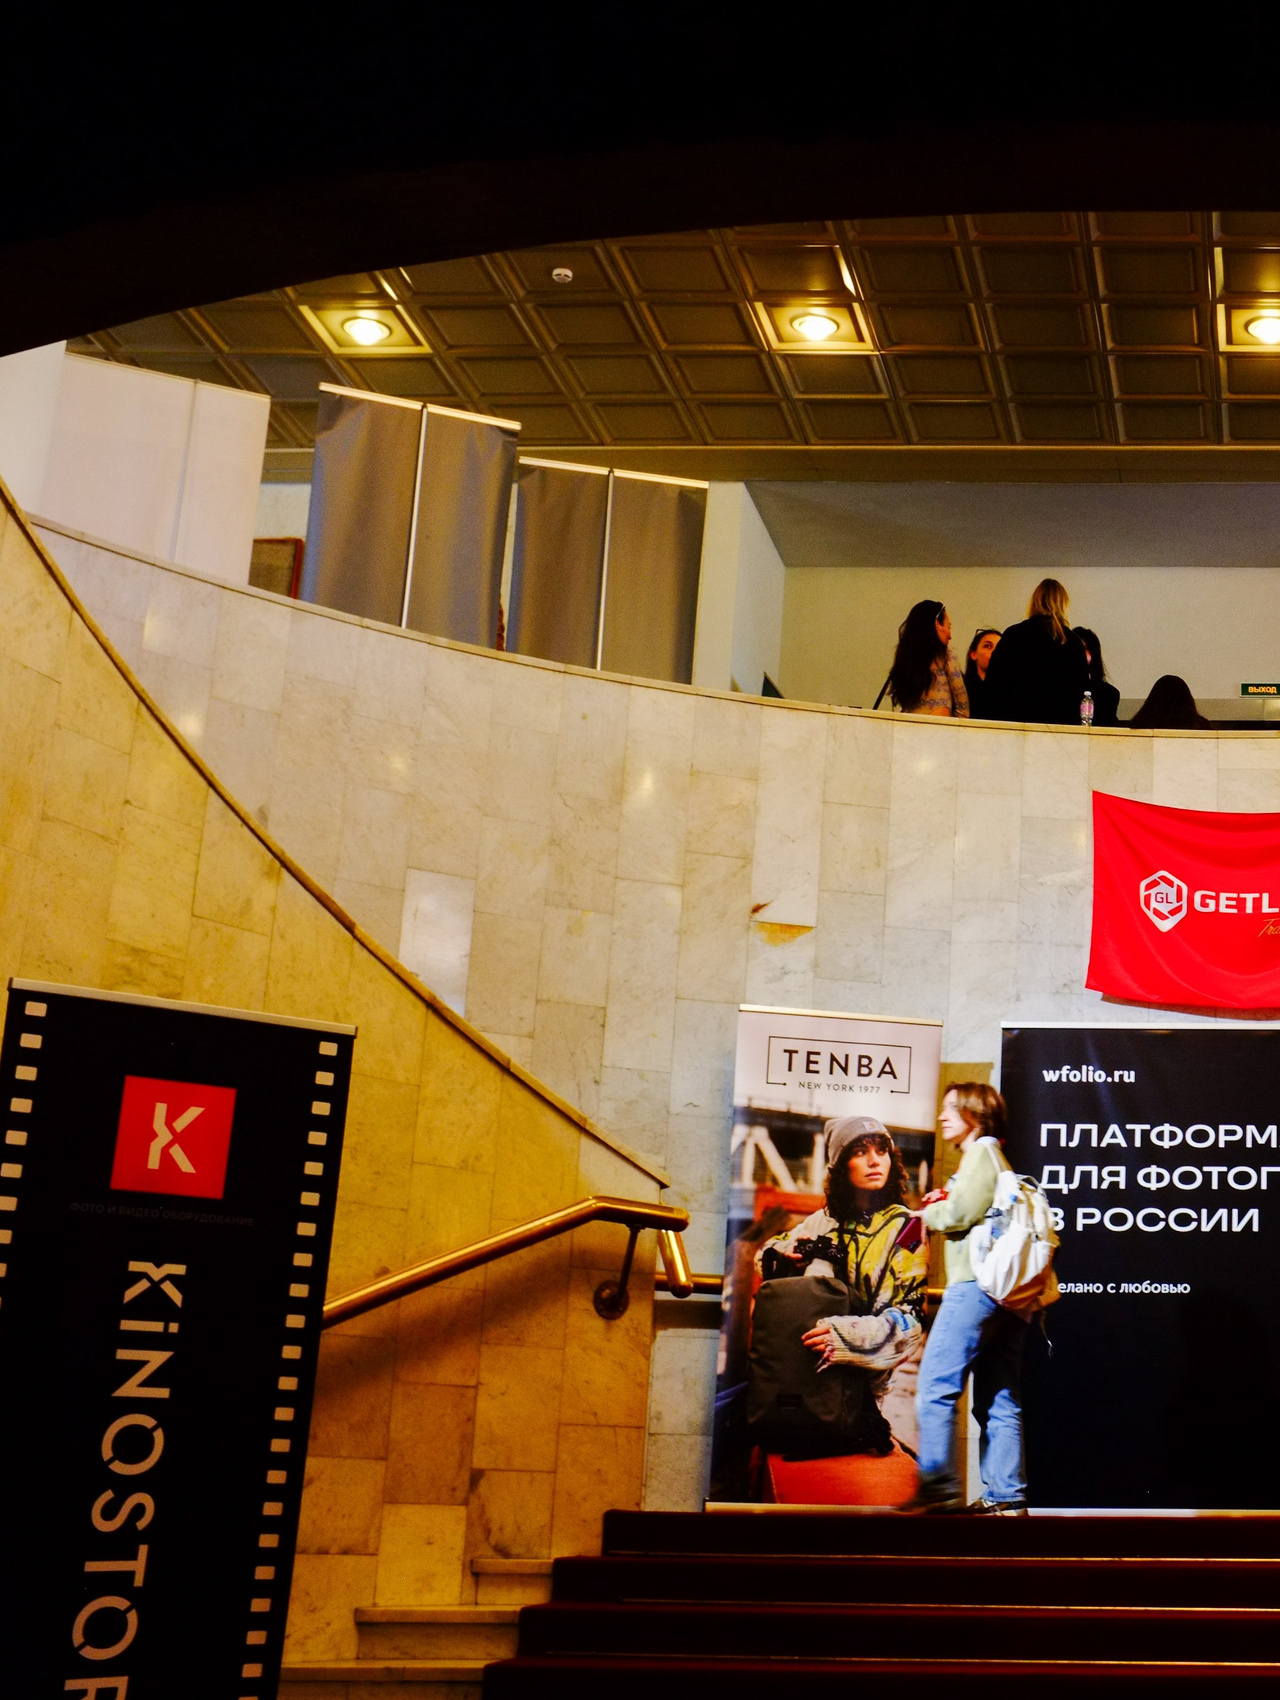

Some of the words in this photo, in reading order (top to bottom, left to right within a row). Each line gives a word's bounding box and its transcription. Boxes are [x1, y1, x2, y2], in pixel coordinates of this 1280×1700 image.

[1248, 686, 1277, 694] ВЫХОД
[1154, 891, 1174, 905] GL
[783, 1049, 898, 1080] TENBA
[1042, 1065, 1136, 1084] wfolio.ru
[798, 1081, 822, 1090] NEW
[826, 1083, 855, 1092] YORK
[859, 1085, 881, 1094] 1977
[147, 1102, 206, 1174] K
[1040, 1165, 1127, 1194] ДЛЯ
[70, 1202, 105, 1213] ФОТО
[119, 1206, 160, 1218] ВИДЕО
[162, 1209, 255, 1226] ОБОРУДОВАНИЕ
[1076, 1207, 1259, 1233] РОССИИ
[1057, 1282, 1104, 1294] елано
[1119, 1280, 1190, 1294] любовью
